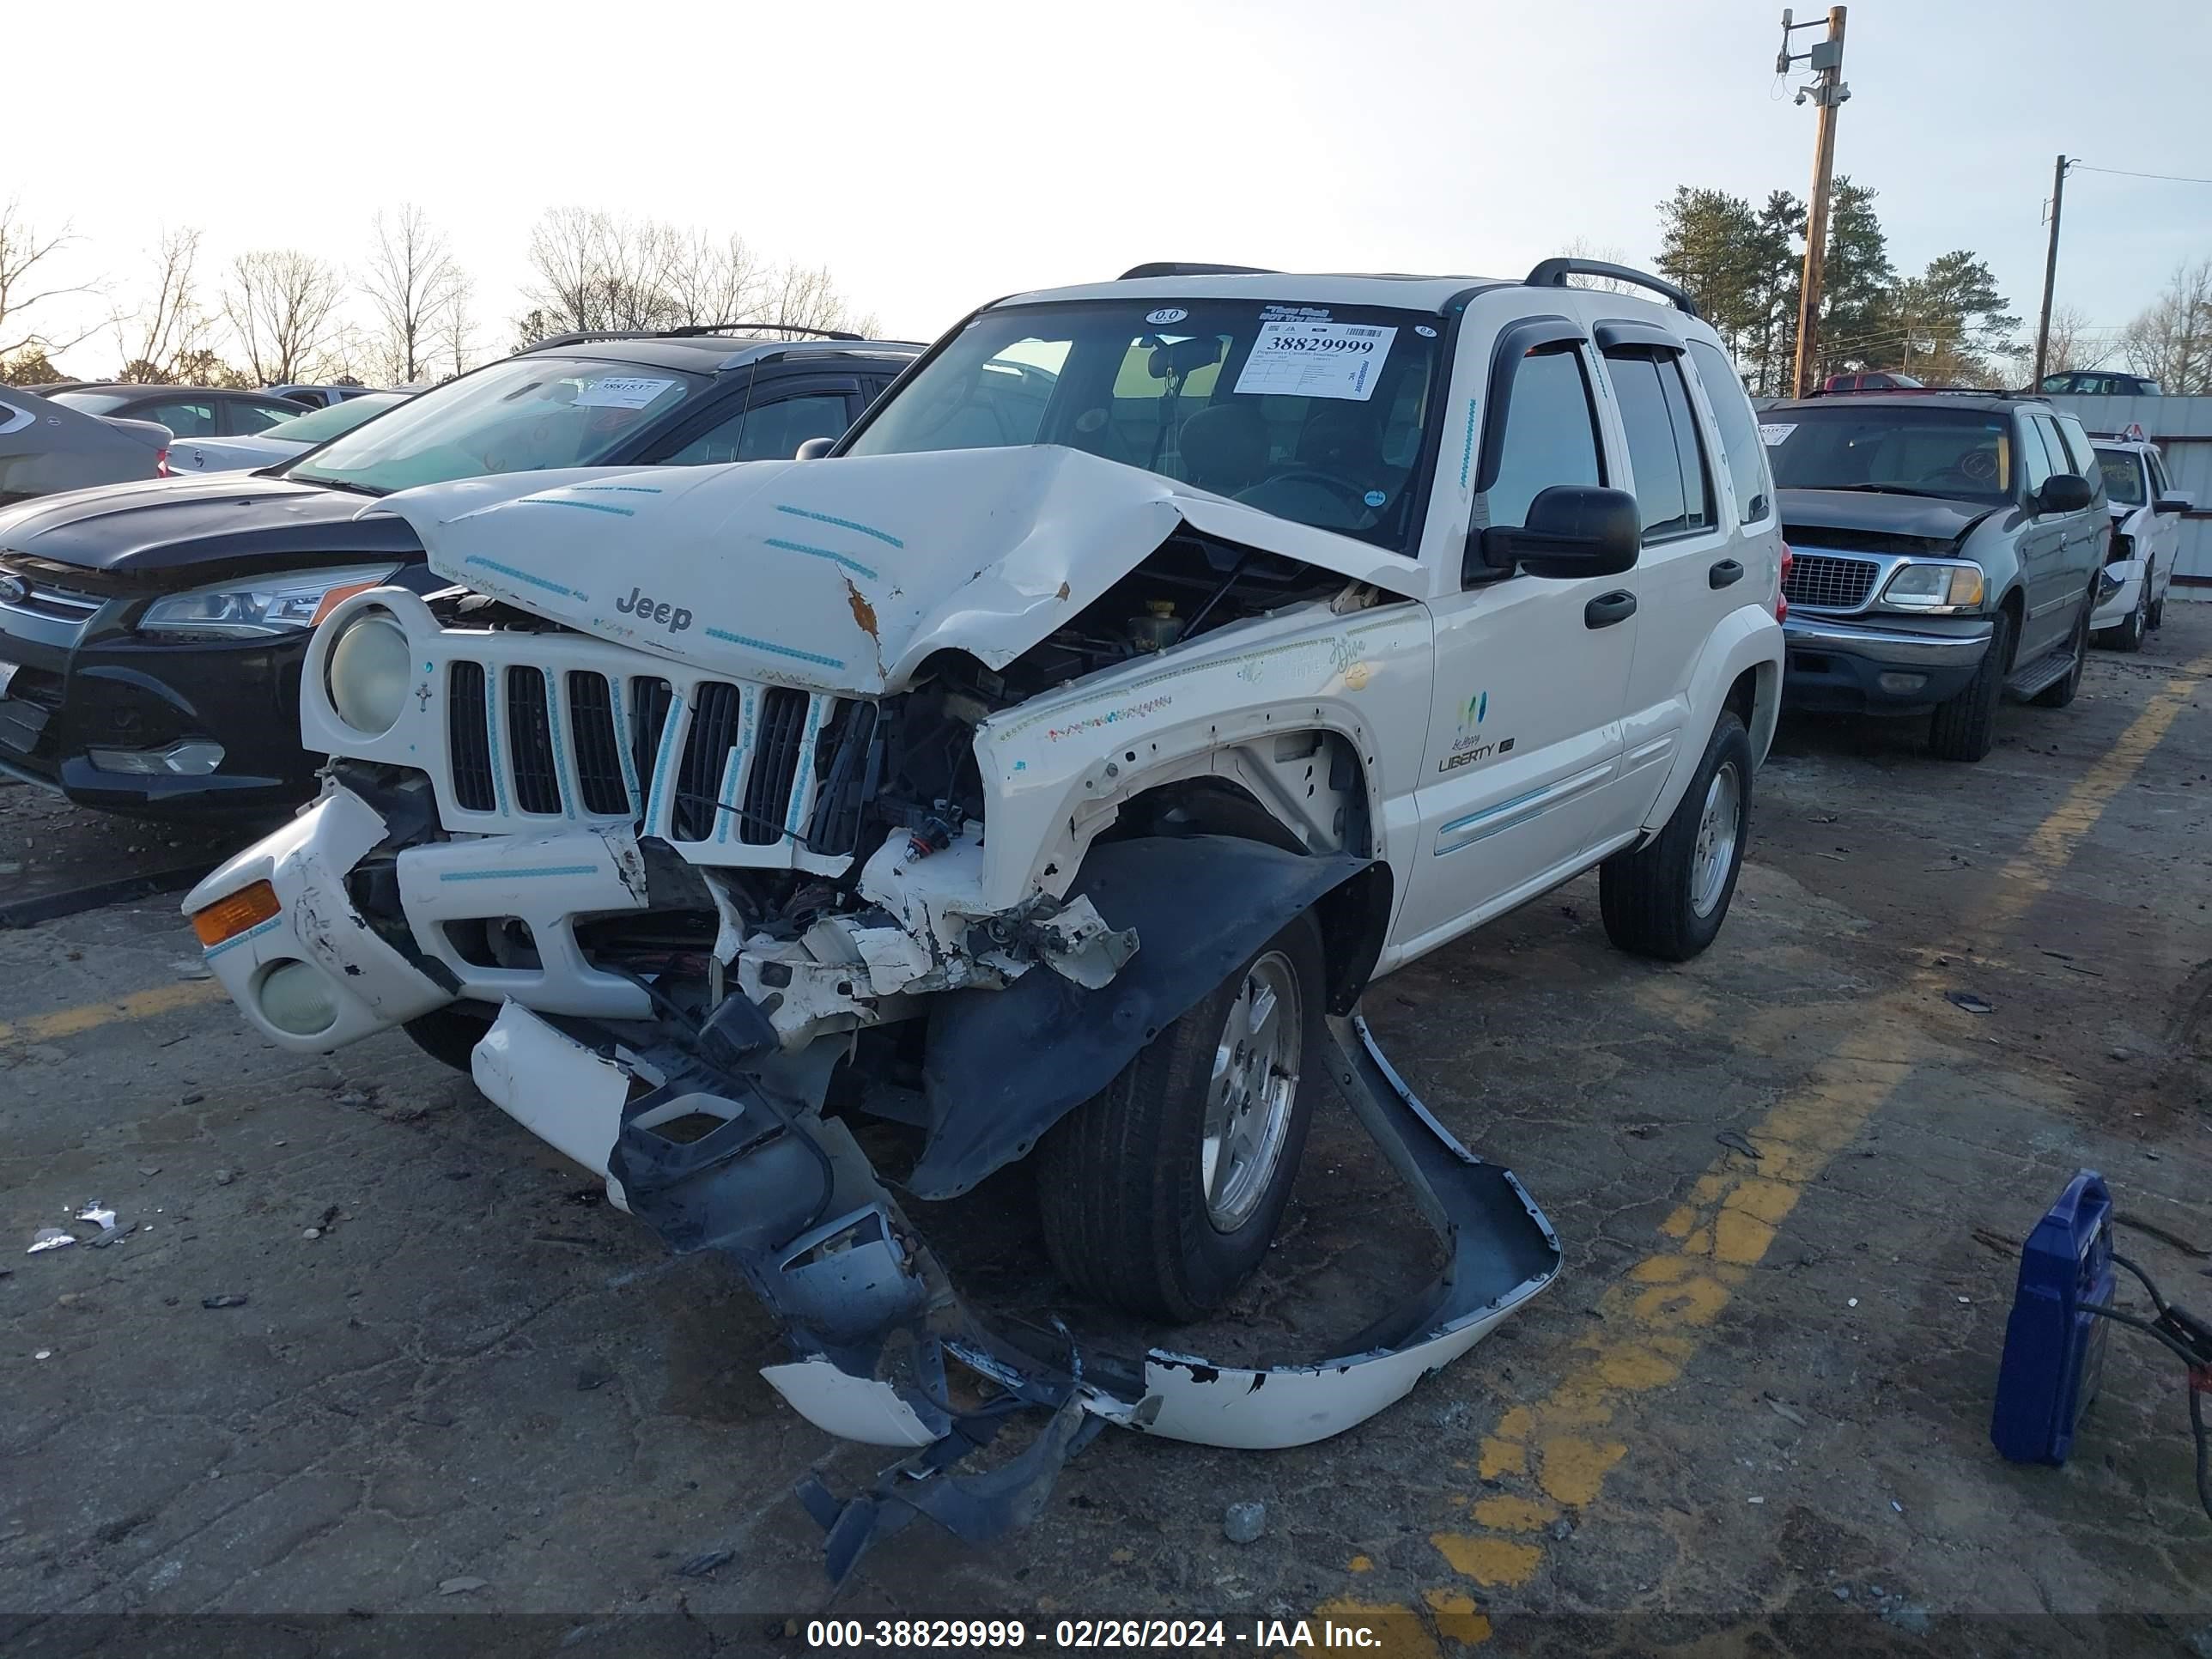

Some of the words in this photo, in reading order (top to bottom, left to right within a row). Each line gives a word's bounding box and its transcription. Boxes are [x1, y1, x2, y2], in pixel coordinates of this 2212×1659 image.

[1155, 310, 1179, 319] 0.0
[1267, 337, 1374, 355] 38829999
[616, 587, 692, 634] Jeep
[1438, 743, 1495, 773] LIBERTY
